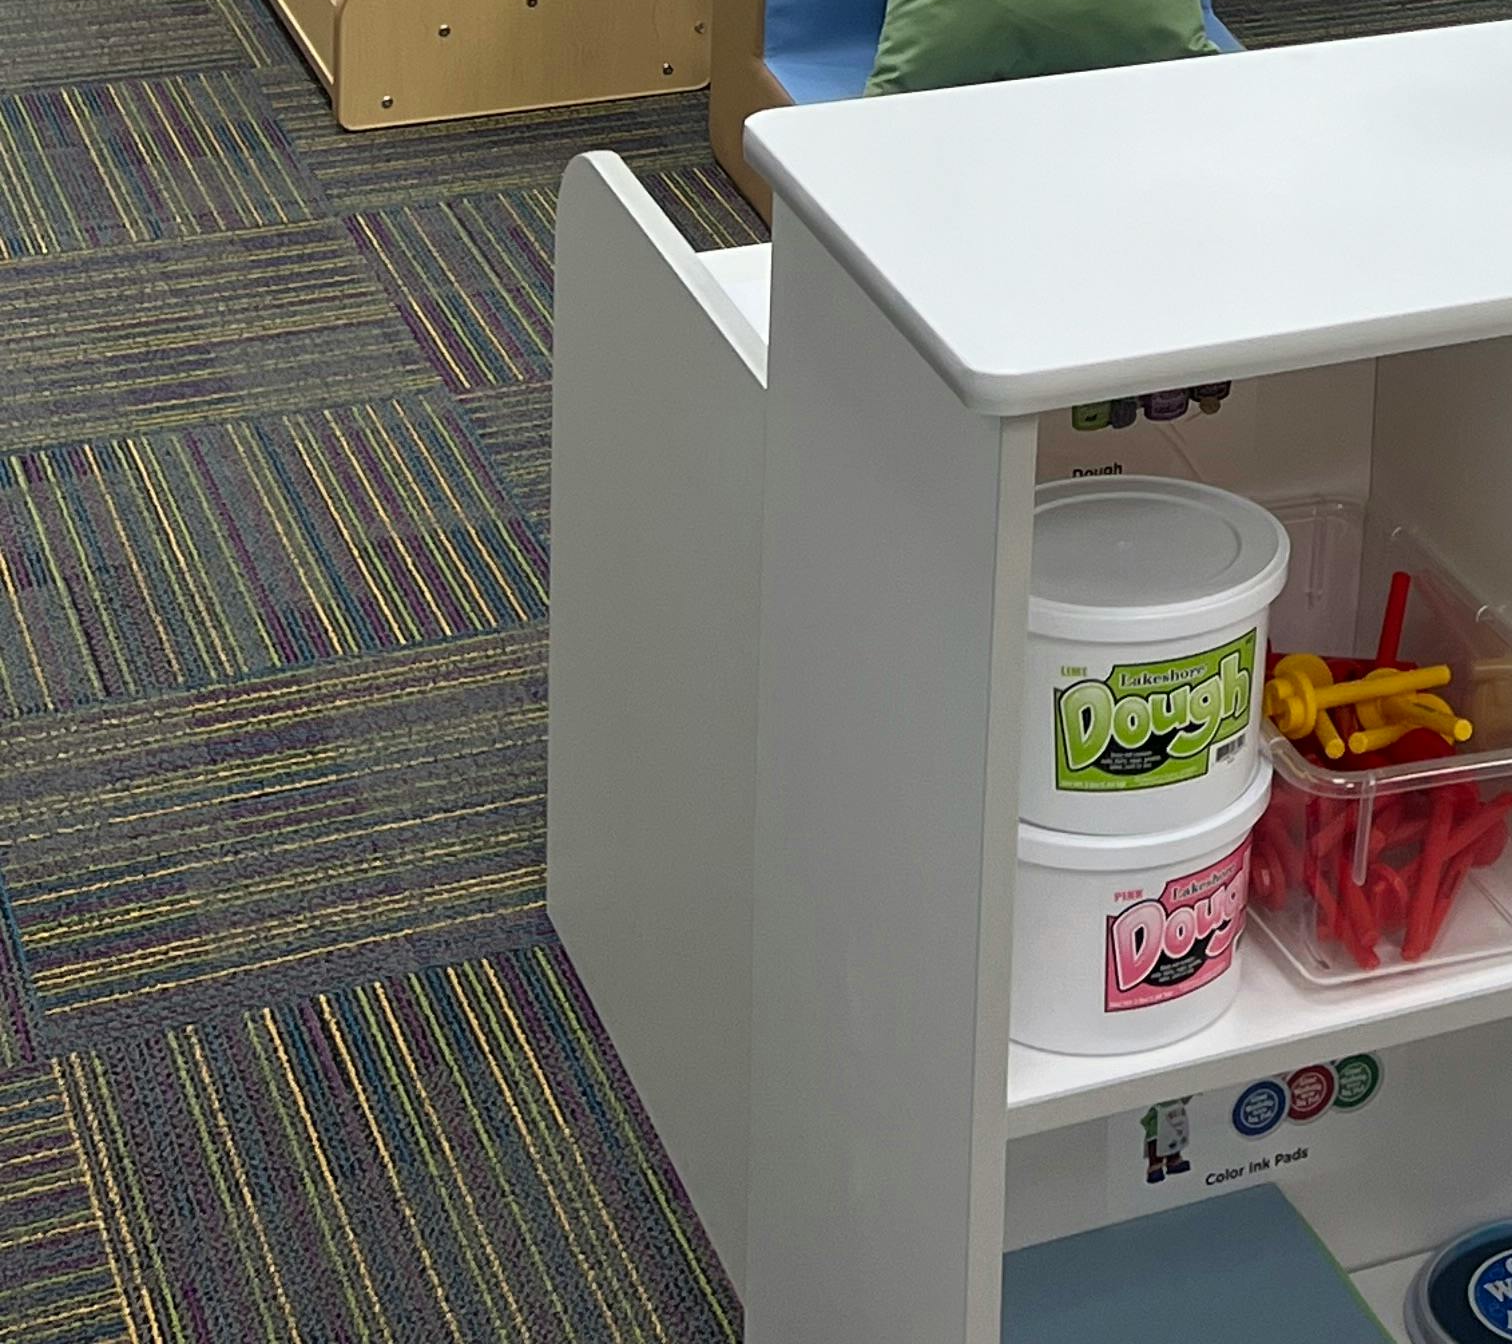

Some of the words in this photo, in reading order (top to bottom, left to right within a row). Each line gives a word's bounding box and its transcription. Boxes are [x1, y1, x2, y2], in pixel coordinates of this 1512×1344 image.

[1061, 665, 1088, 678] LIME
[1119, 663, 1206, 688] Lakeshore
[1059, 650, 1250, 771] Dough
[1114, 889, 1144, 902] PINK
[1205, 1166, 1245, 1186] Color
[1249, 1157, 1271, 1174] Ink
[1275, 1148, 1309, 1166] Pads
